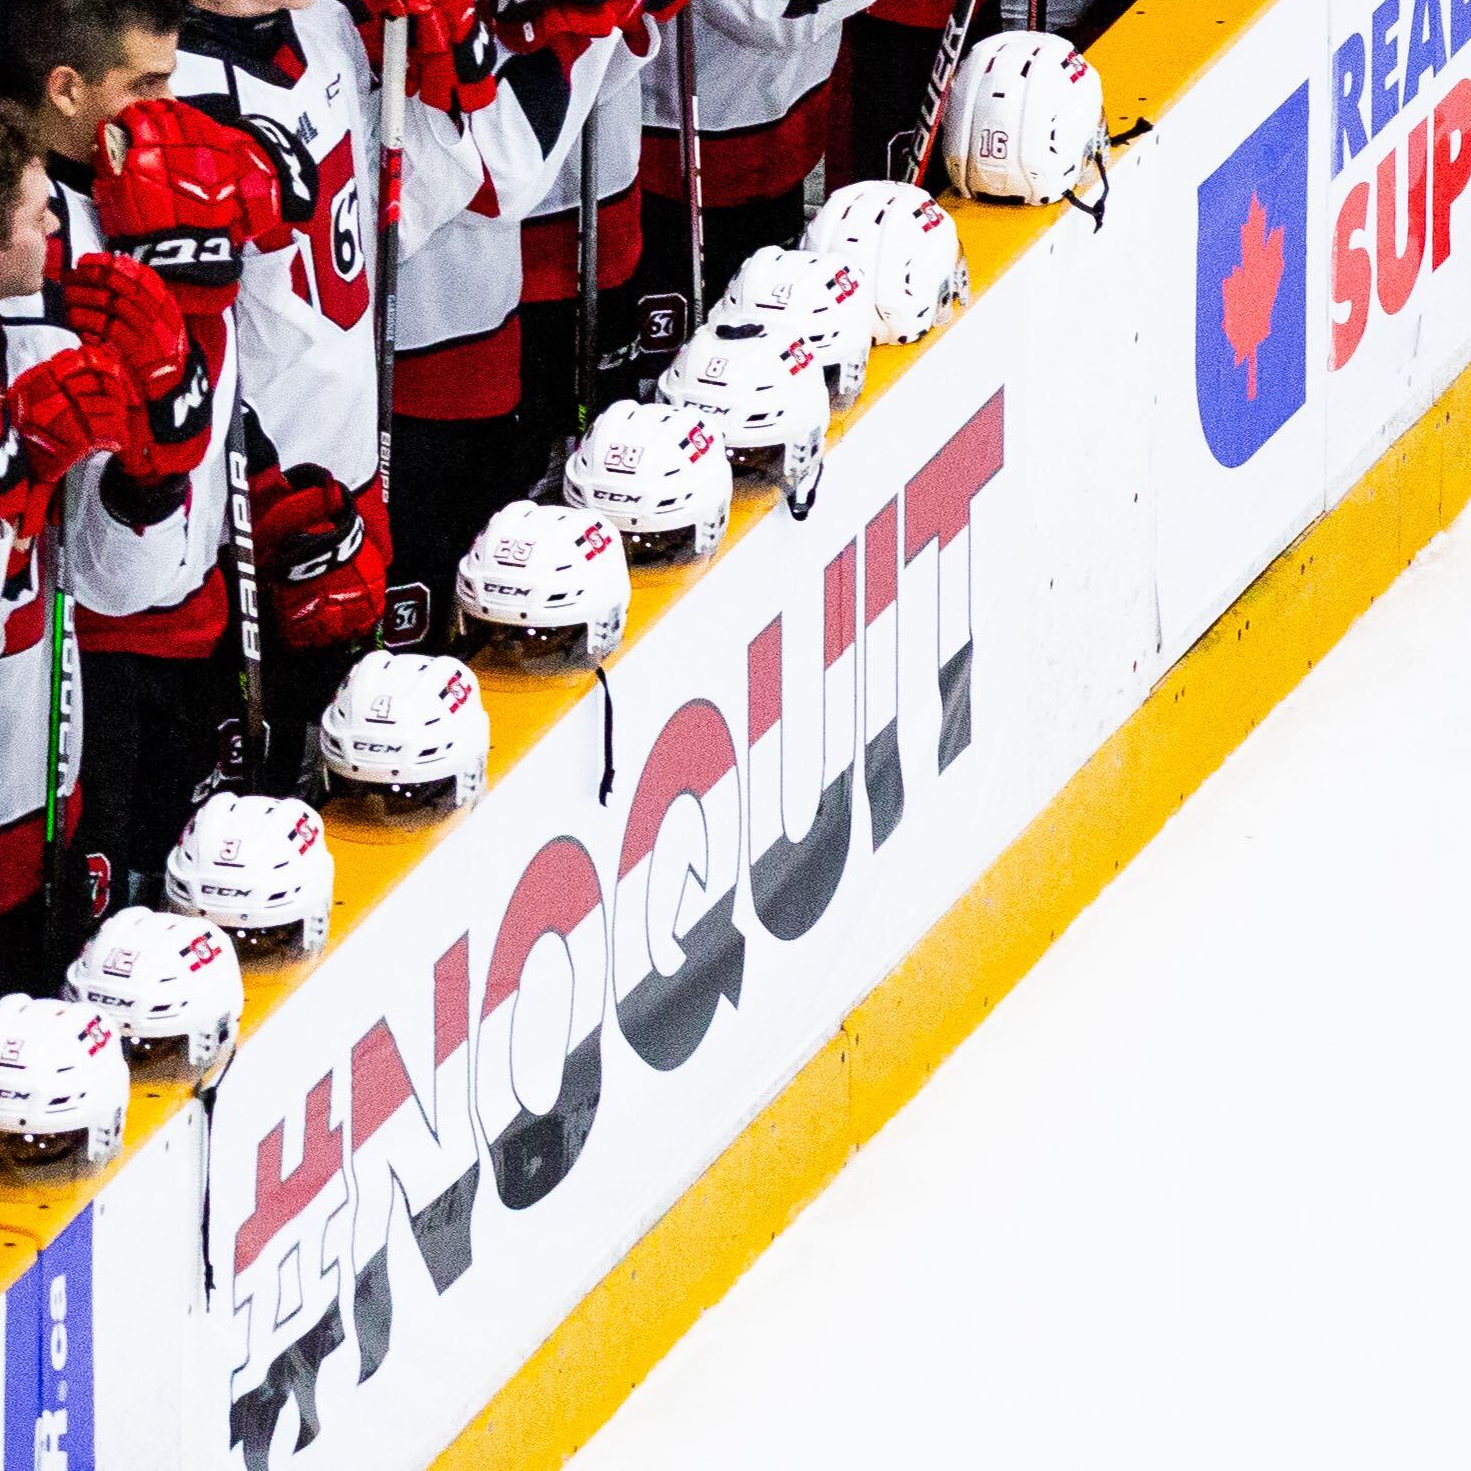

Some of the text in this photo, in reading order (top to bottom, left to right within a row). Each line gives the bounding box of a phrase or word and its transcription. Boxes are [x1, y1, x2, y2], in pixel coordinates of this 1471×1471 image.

[979, 129, 1008, 160] 16
[605, 443, 645, 469] 28
[592, 488, 643, 505] CCM
[494, 536, 534, 562] 25
[483, 583, 531, 598] CCM
[369, 694, 393, 719] 4
[353, 740, 402, 754] CCM
[201, 884, 253, 898] CCM
[228, 383, 1005, 1471] #NOQUIT
